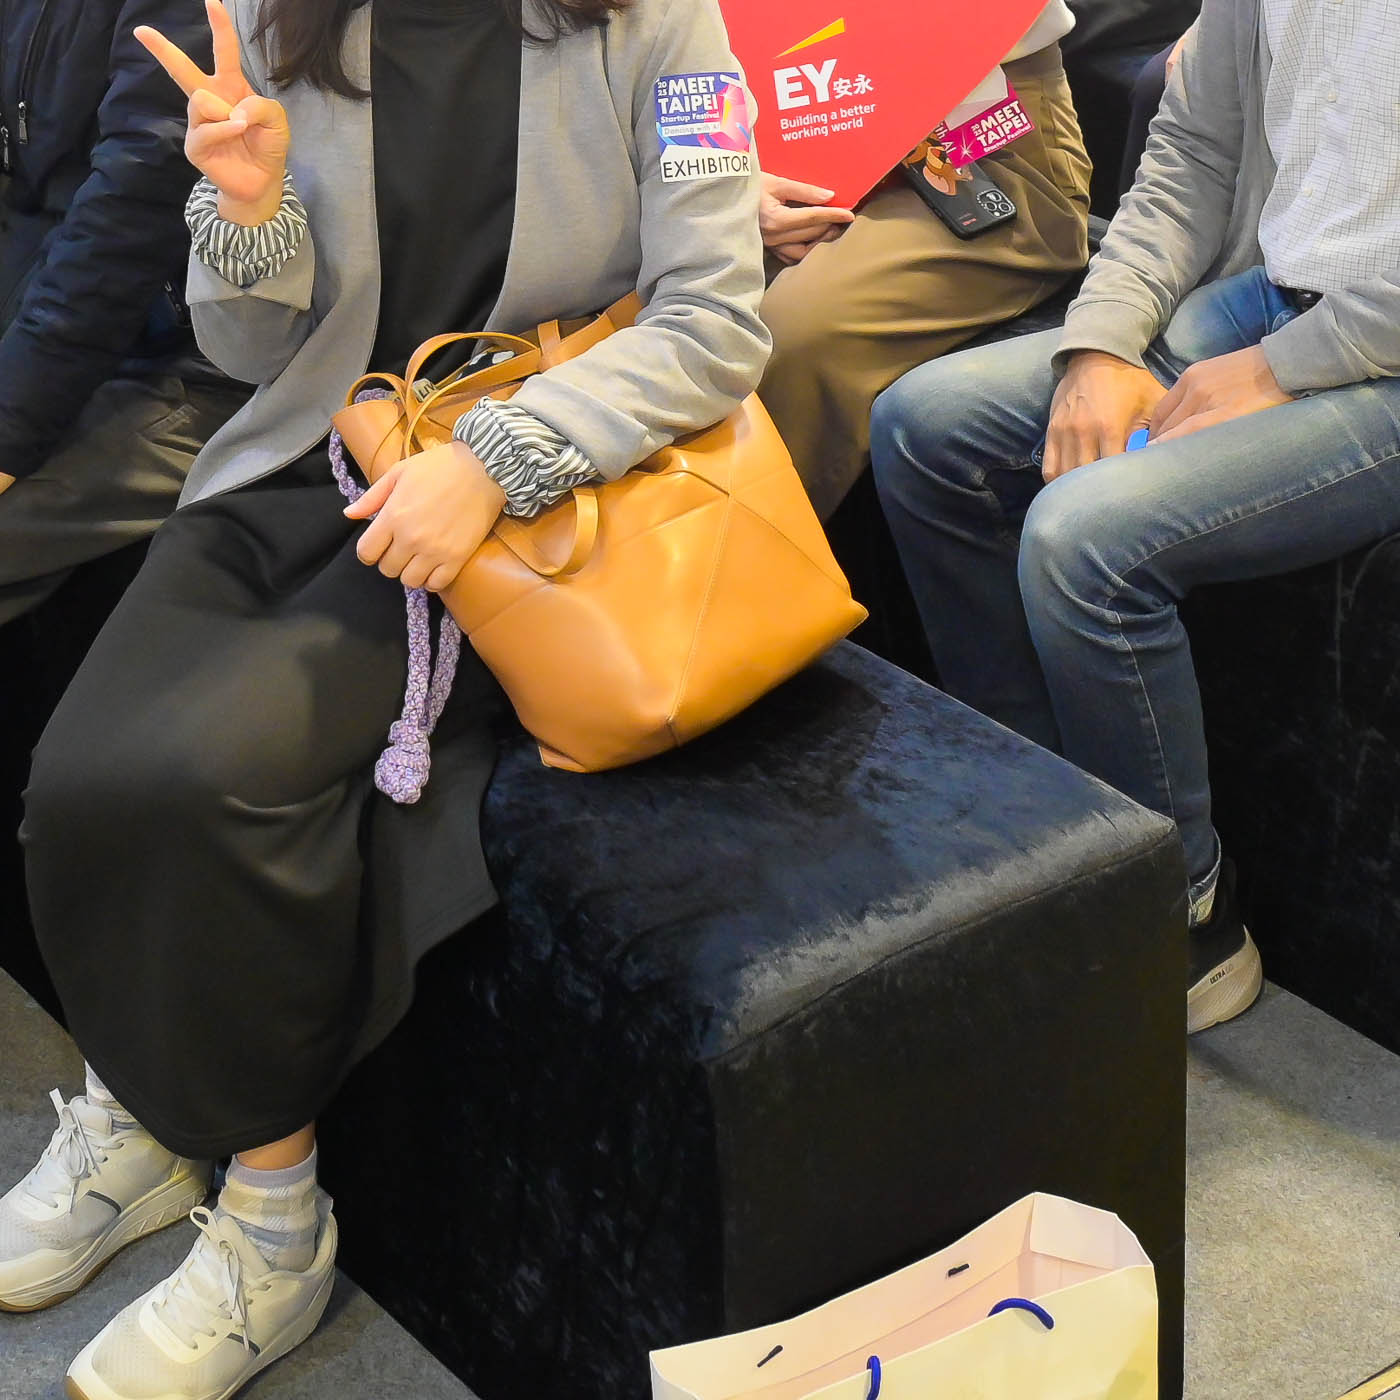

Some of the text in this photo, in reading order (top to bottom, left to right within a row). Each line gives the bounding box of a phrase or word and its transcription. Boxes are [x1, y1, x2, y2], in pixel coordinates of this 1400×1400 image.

[668, 76, 715, 96] MEET
[773, 58, 838, 110] EY
[658, 94, 718, 114] TAIPEI
[980, 100, 1022, 132] MEET
[660, 115, 690, 123] Startup
[780, 104, 876, 130] Building a better
[782, 117, 864, 142] working world
[976, 112, 1029, 147] TAIPEI
[663, 156, 749, 178] EXHIBITOR
